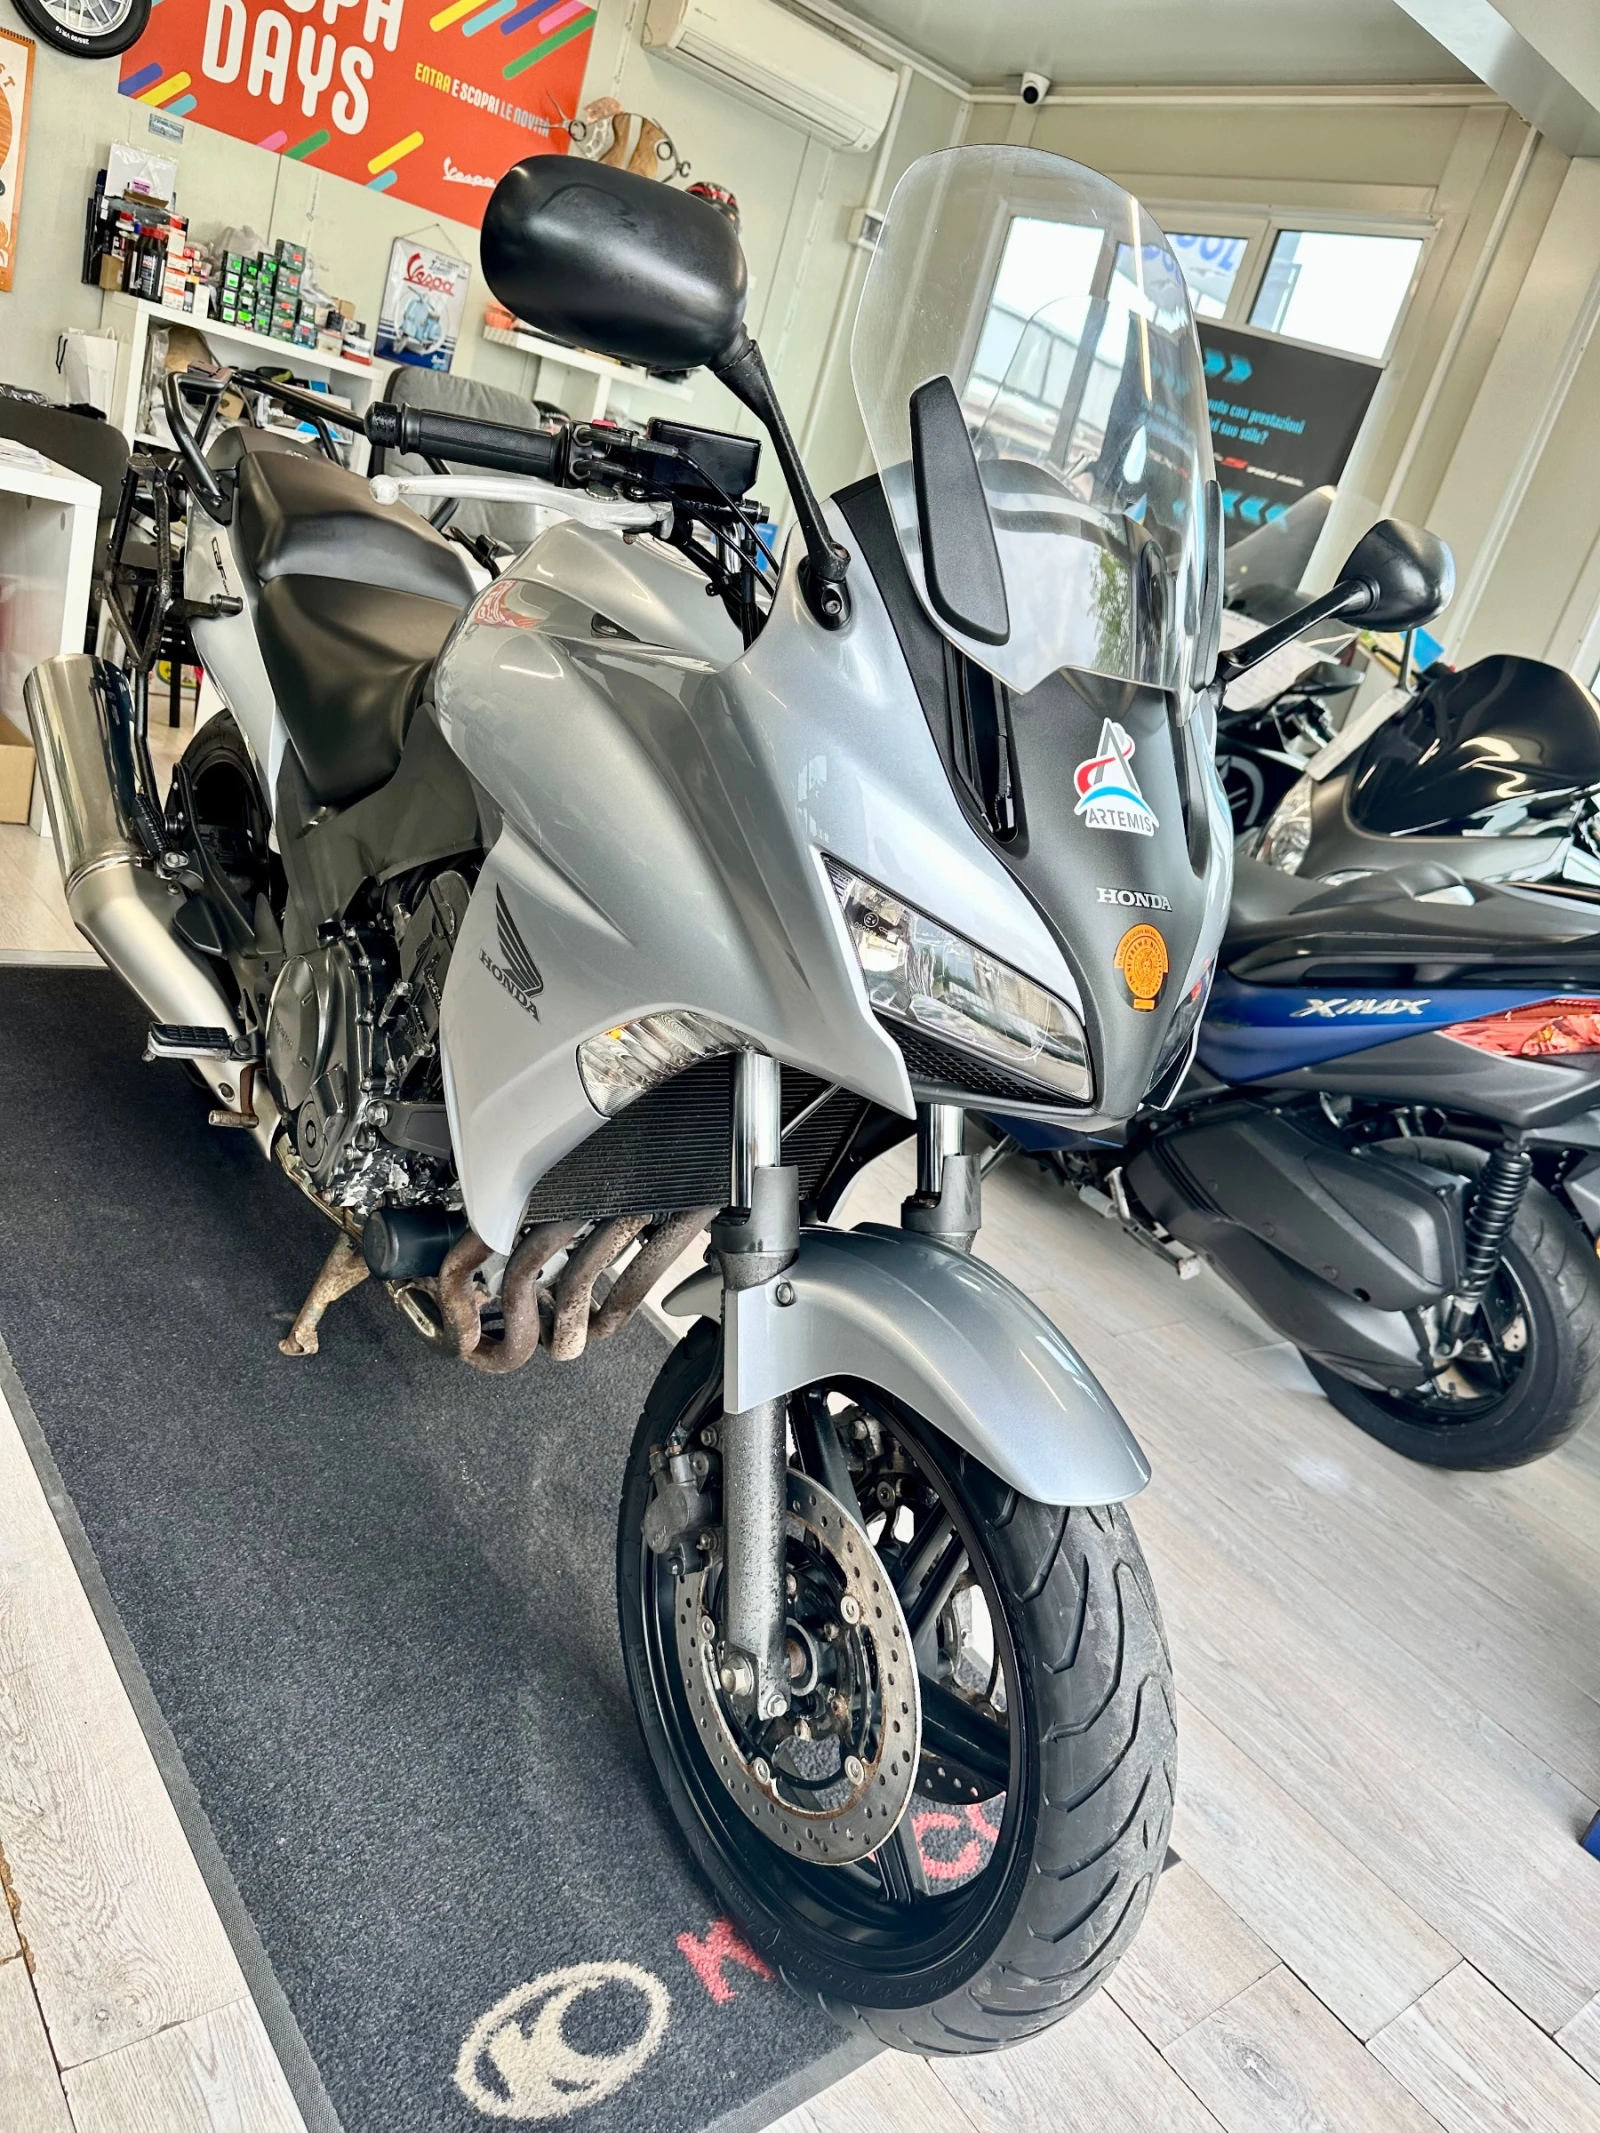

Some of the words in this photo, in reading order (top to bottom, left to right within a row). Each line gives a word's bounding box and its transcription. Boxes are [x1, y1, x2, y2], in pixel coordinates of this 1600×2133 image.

[202, 0, 374, 135] DAYS
[414, 62, 451, 93] ENTRA
[451, 78, 460, 98] E
[460, 82, 500, 115] SCOPRI
[500, 101, 513, 121] LE
[442, 156, 497, 189] Vespa
[403, 252, 455, 297] Vespa
[1219, 422, 1240, 438] suo
[1229, 404, 1250, 420] con
[1248, 409, 1307, 435] prestazioni
[211, 536, 227, 580] CBF
[1087, 806, 1153, 833] ARTEMIS
[1096, 887, 1173, 912] HONDA
[479, 948, 541, 1023] HONDA
[1290, 998, 1432, 1018] XMAX
